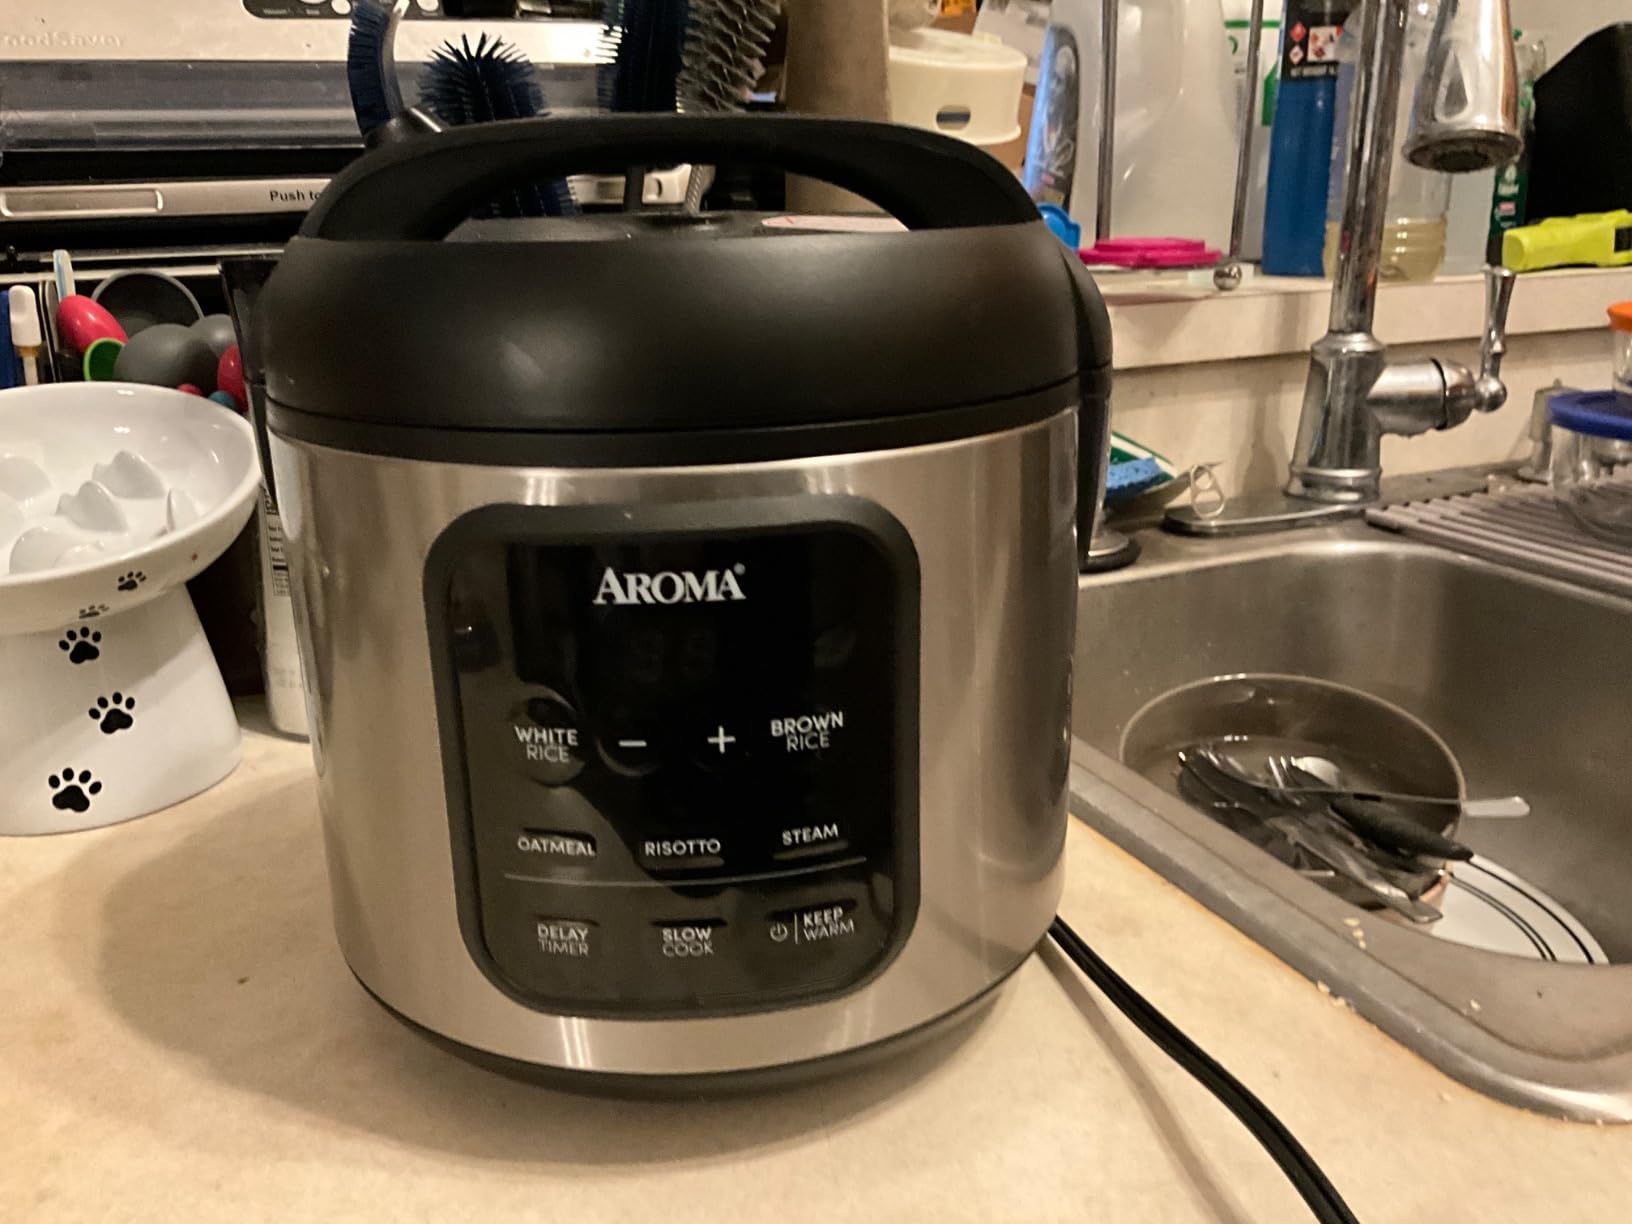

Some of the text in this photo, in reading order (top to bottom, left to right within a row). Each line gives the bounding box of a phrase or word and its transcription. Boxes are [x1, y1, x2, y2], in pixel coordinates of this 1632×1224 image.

[0, 31, 124, 48] oodSaver
[269, 189, 305, 201] Push
[593, 566, 746, 604] AROMA
[770, 711, 844, 736] BROWN
[514, 726, 578, 746] WHITE
[786, 733, 829, 751] RICE
[526, 745, 569, 763] RICE
[782, 823, 838, 846] STEAM
[517, 836, 596, 856] OATMEAL
[644, 839, 721, 857] RISOTTO
[803, 907, 843, 927] KEEP
[537, 922, 589, 941] DELAY
[662, 927, 712, 943] SLOW
[803, 919, 854, 941] WARM
[538, 939, 589, 957] TIMER
[662, 942, 714, 957] COOK
